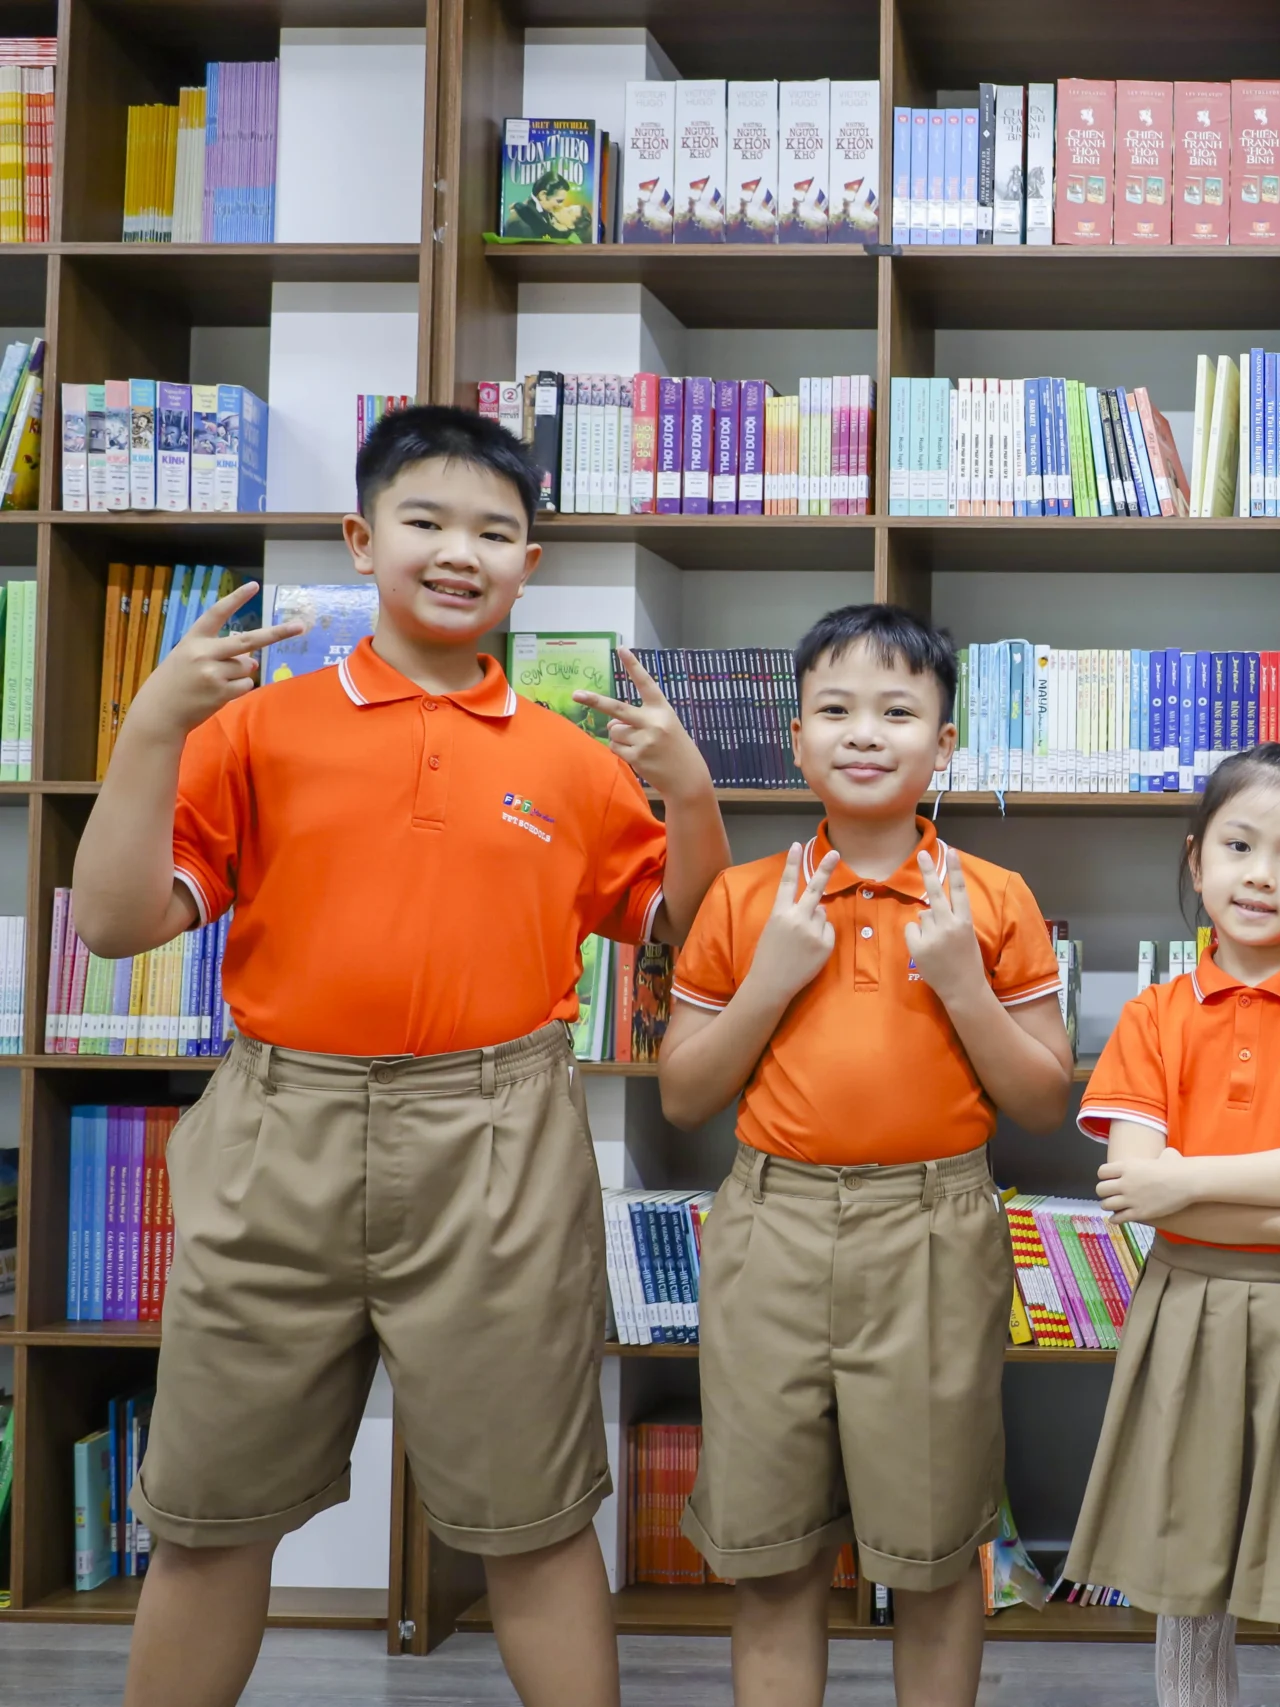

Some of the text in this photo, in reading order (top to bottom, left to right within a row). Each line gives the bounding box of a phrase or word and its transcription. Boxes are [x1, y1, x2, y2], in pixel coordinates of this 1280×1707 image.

[1064, 137, 1105, 148] TRANH
[1123, 138, 1164, 148] TRANH
[1182, 138, 1222, 149] TRANH
[1239, 137, 1279, 147] TRANH
[547, 134, 589, 164] THEO
[329, 646, 352, 654] HY
[1038, 680, 1047, 714] MAYA
[504, 794, 531, 811] FPT
